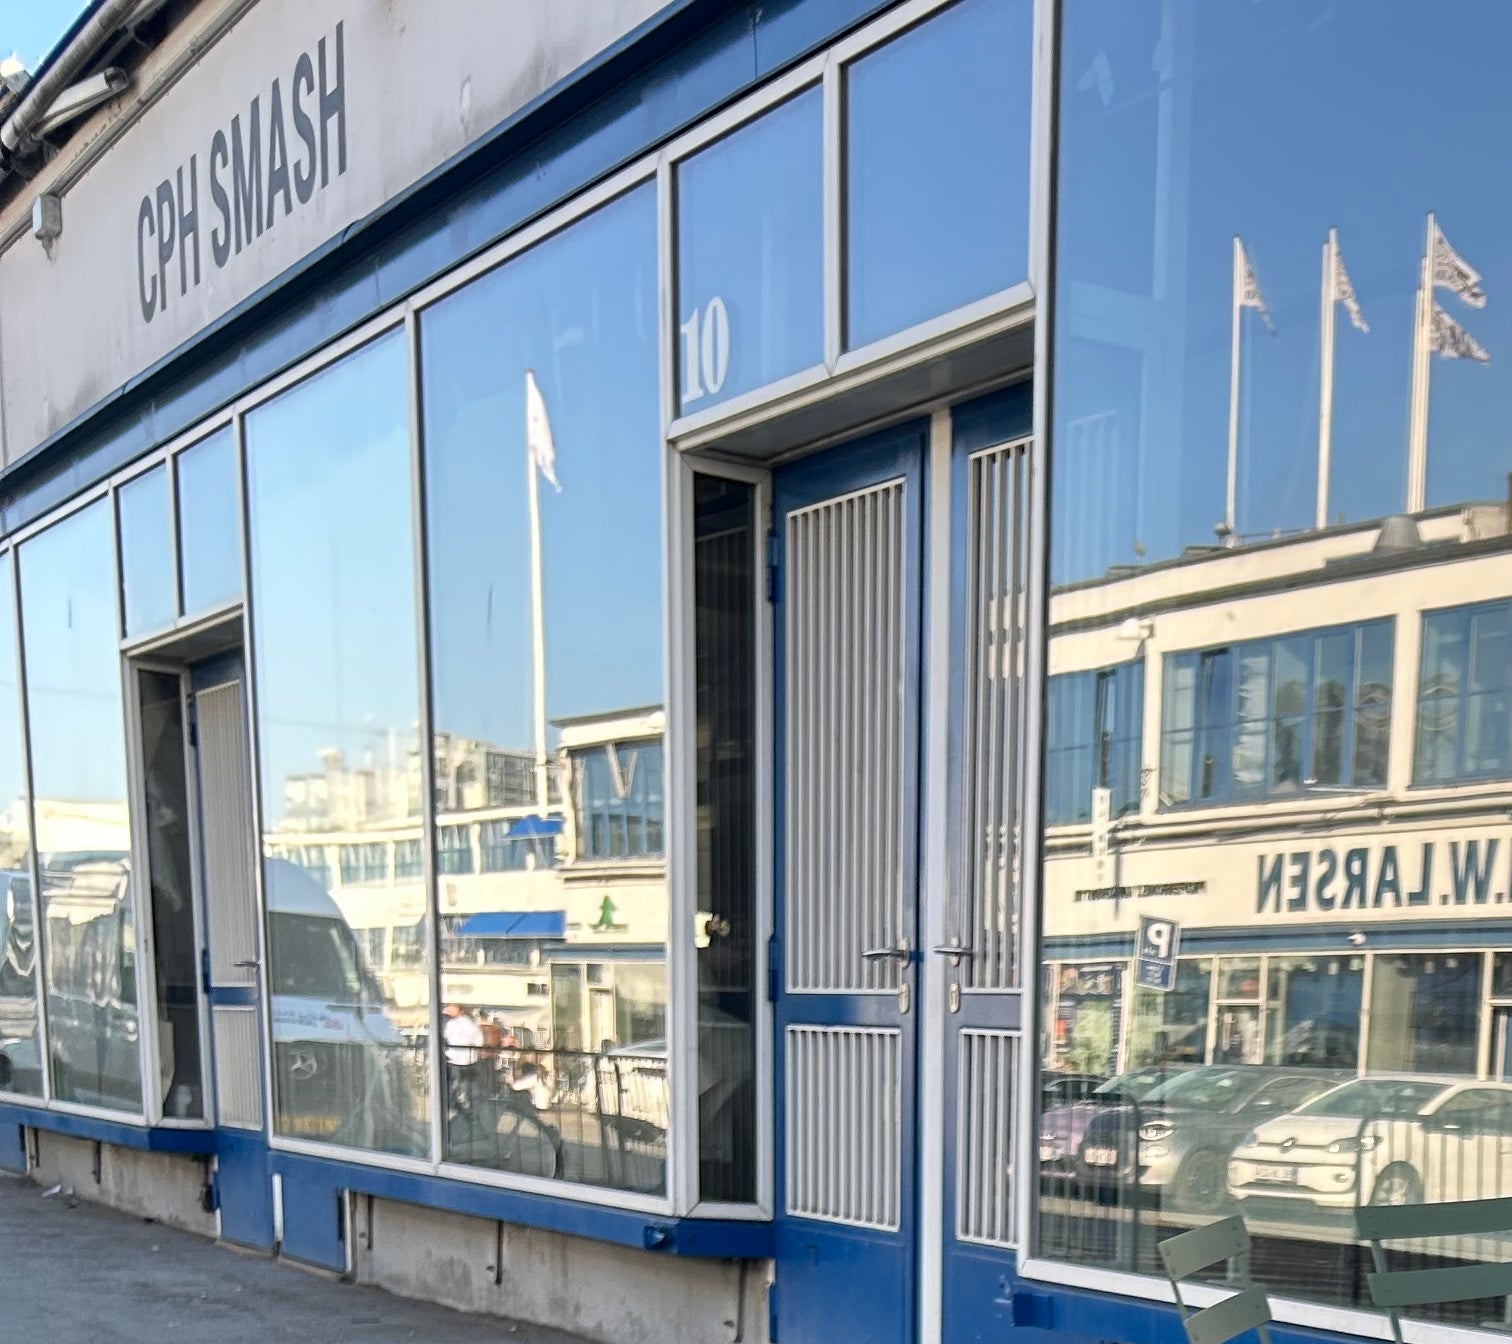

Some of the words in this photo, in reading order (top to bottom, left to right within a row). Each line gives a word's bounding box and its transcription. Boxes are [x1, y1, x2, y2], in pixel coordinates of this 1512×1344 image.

[136, 154, 201, 324] CPH
[210, 20, 347, 269] SMASH
[680, 296, 730, 404] 10
